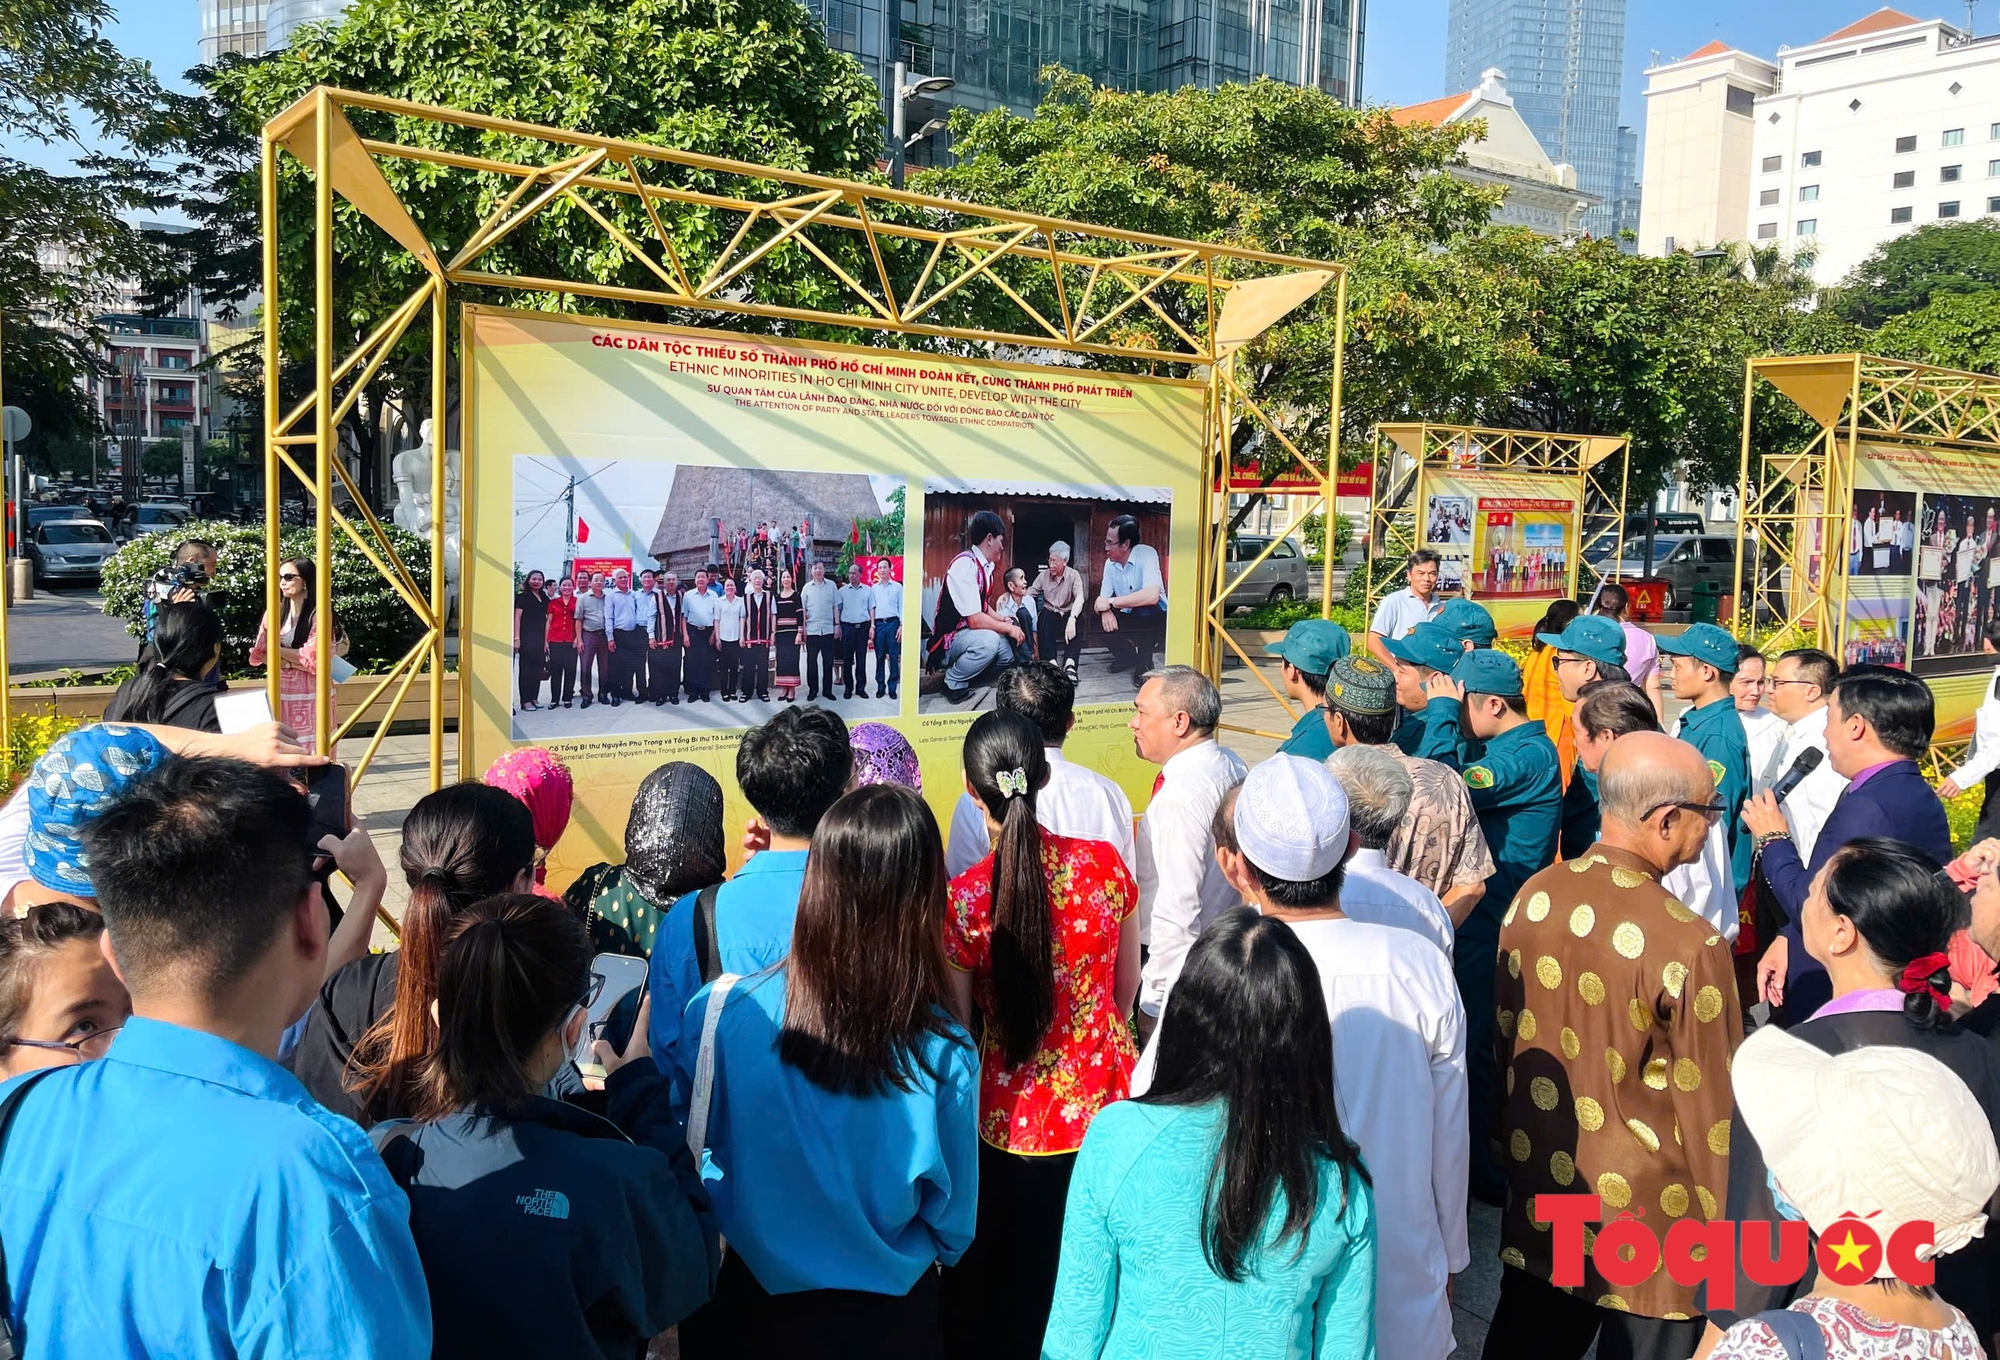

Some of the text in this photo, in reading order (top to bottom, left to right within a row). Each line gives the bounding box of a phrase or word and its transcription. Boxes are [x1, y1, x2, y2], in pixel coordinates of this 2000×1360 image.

[592, 333, 1133, 398] CÁC DÂN TỘC THIỂU SỐ THÀNH PHỐ HỒ CHÍ MINH ĐOÀN KẾT, CÙNG THÀNH PHỐ PHÁT TRIỂN
[669, 361, 1082, 409] ETHNIC MINORITIES IN HO CHI MINH CITY UNITE, DEVELOP WITH THE CITY
[723, 385, 752, 396] QUAN
[734, 398, 1035, 430] THE ATTENTION OF PARTY AND STATE LEADERS TOWARDS ETHNIC COMPATRIOTS
[549, 744, 559, 752] Cố
[561, 743, 578, 752] Tổng
[580, 743, 587, 751] Bí
[589, 742, 600, 750] thư
[602, 740, 627, 749] Nguyễn
[673, 735, 689, 744] Tổng
[585, 751, 616, 759] Secretary
[618, 750, 642, 758] Nguyen
[690, 744, 713, 752] General
[535, 1188, 556, 1199] THE
[515, 1195, 553, 1208] NORTH
[524, 1205, 551, 1217] FACE
